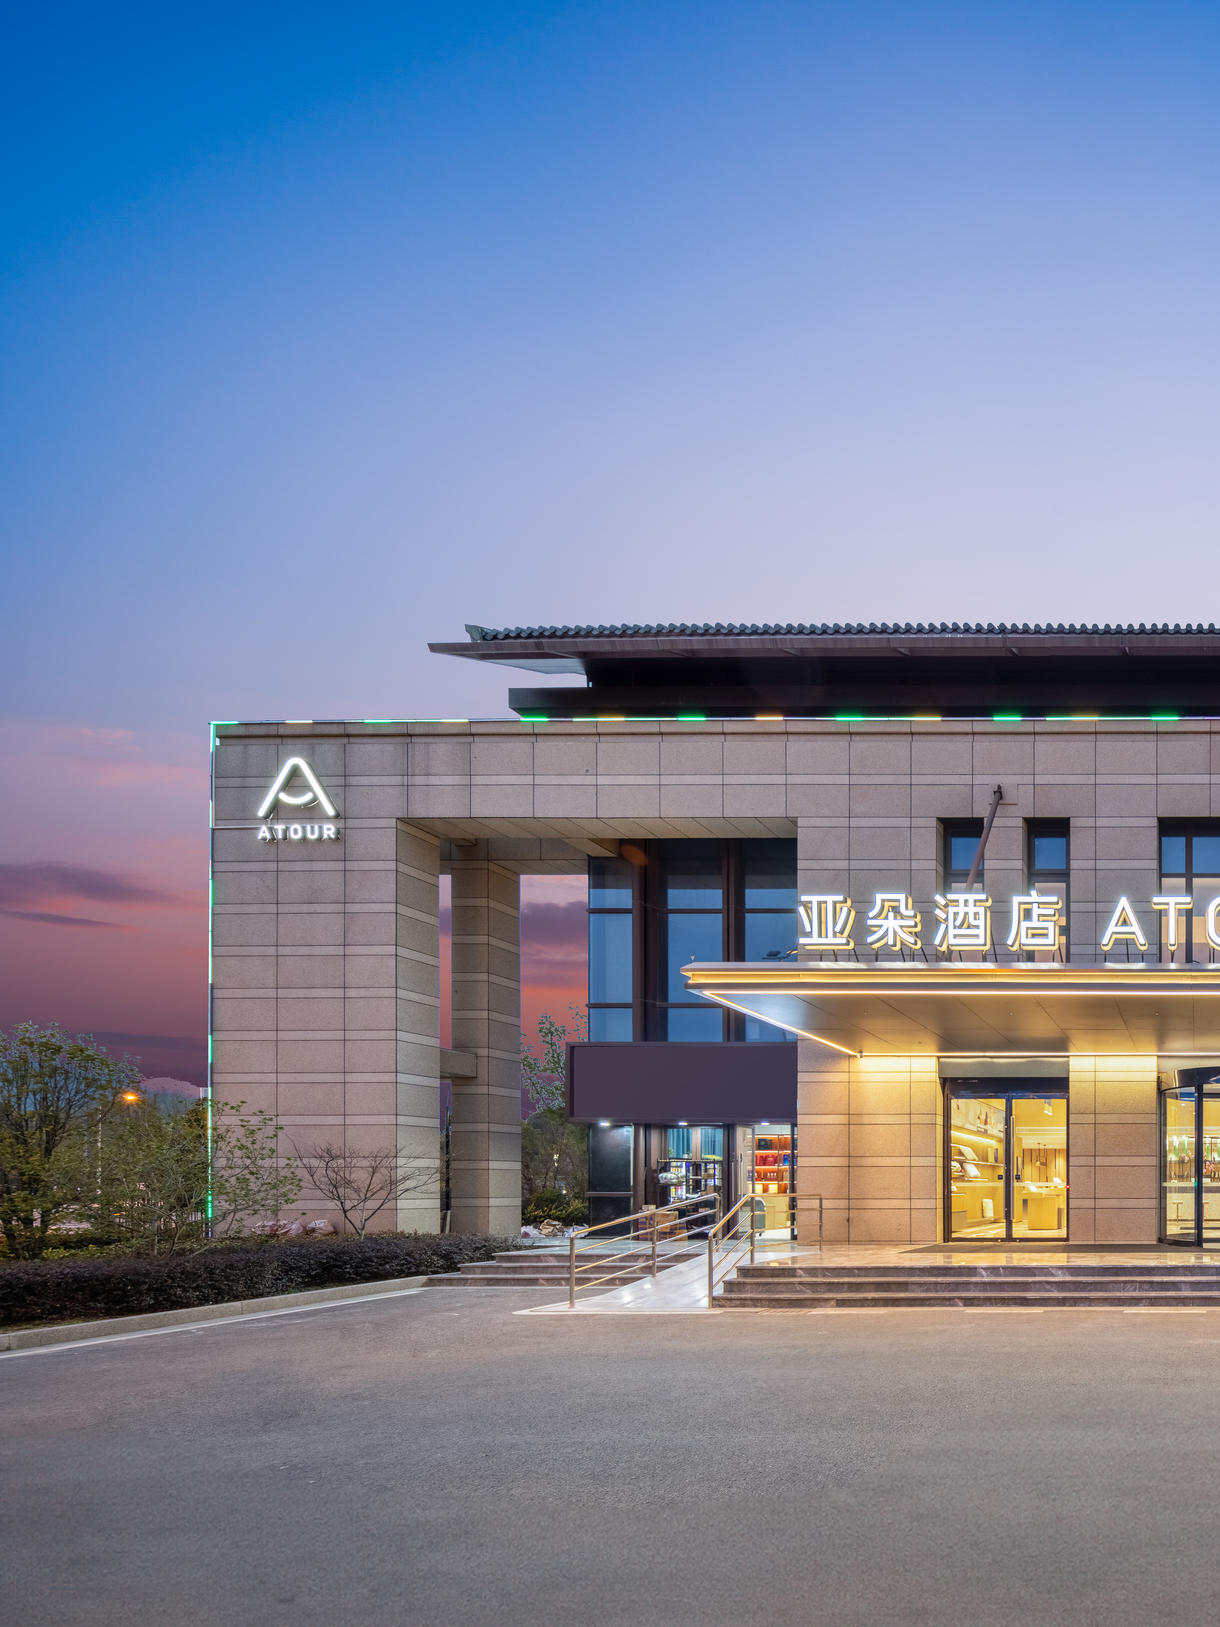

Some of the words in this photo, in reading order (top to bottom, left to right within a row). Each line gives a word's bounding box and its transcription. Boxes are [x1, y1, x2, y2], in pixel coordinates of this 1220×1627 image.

[257, 823, 336, 840] ATOUR
[798, 890, 1062, 951] 亚朵酒店
